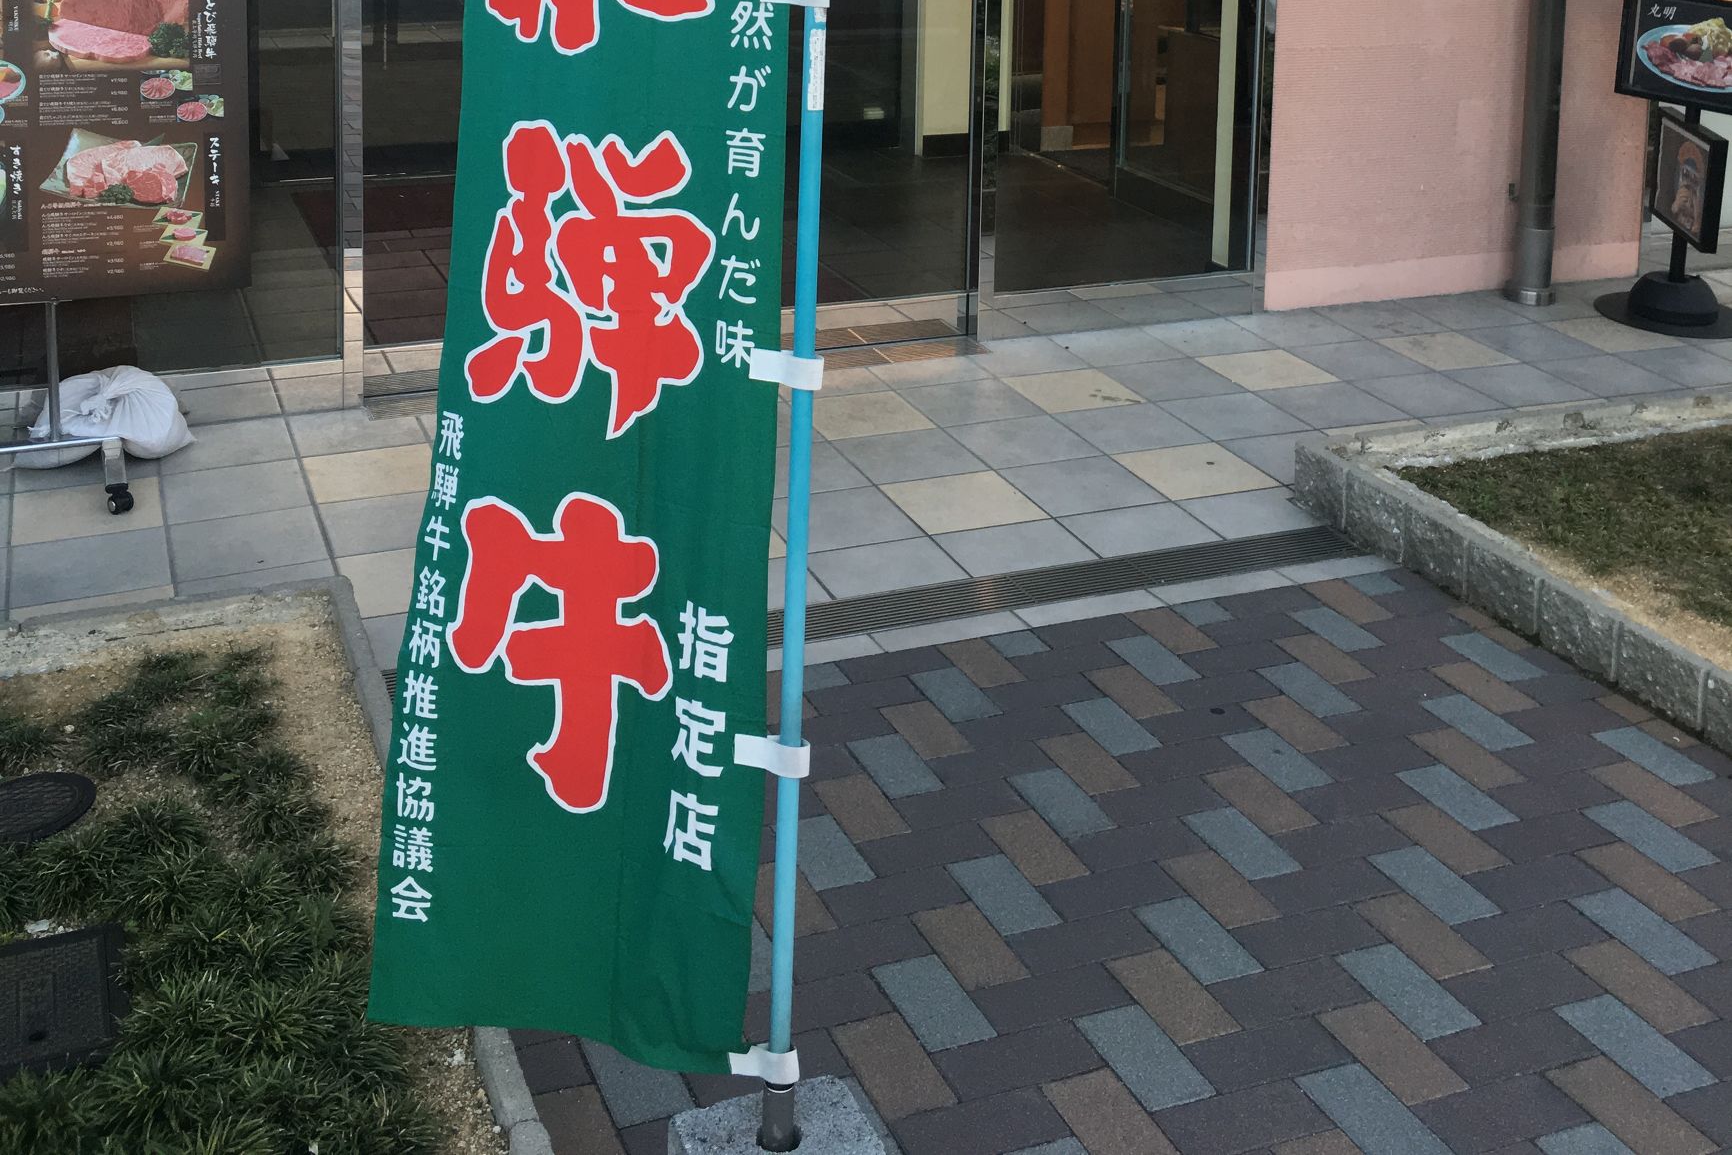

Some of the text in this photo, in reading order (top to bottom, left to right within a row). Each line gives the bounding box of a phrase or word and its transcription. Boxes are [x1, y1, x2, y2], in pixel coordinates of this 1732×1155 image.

[1648, 3, 1677, 21] 丸明
[208, 137, 221, 186] ステーキ
[390, 410, 465, 923] 飛騨牛銘柄推進協議会
[663, 600, 735, 872] 指定店
